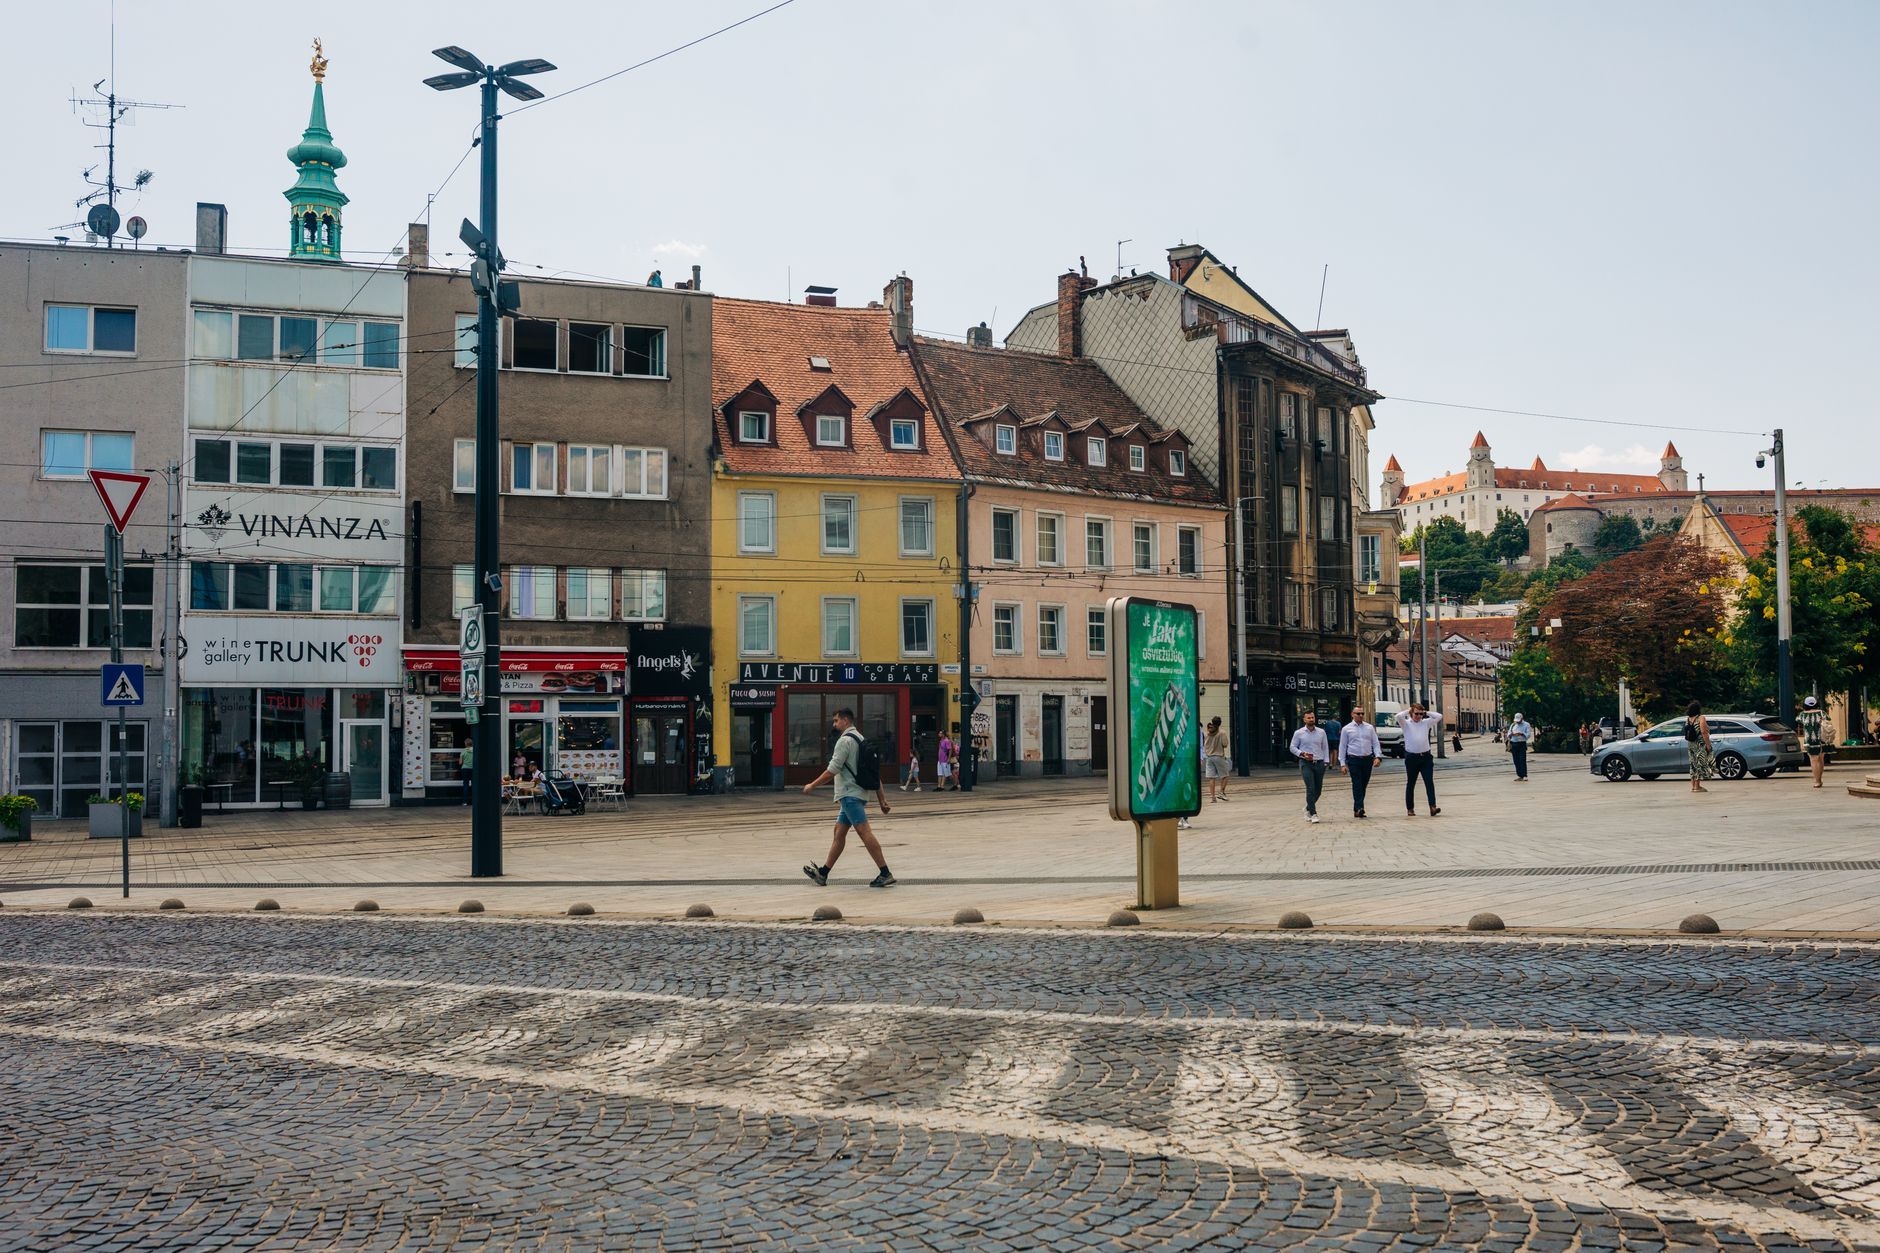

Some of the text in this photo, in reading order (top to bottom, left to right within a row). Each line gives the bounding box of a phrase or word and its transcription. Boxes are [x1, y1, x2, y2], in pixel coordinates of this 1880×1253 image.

[205, 637, 251, 648] wine
[255, 641, 346, 662] TRUNK
[204, 651, 250, 665] gallery
[637, 654, 682, 672] Angel's
[744, 664, 855, 682] AVENUE 10
[864, 665, 934, 673] COFFEE
[870, 673, 928, 682] & BAR
[512, 681, 534, 689] Pizza
[1328, 682, 1356, 690] CHANNELS
[266, 695, 327, 710] TRUNK
